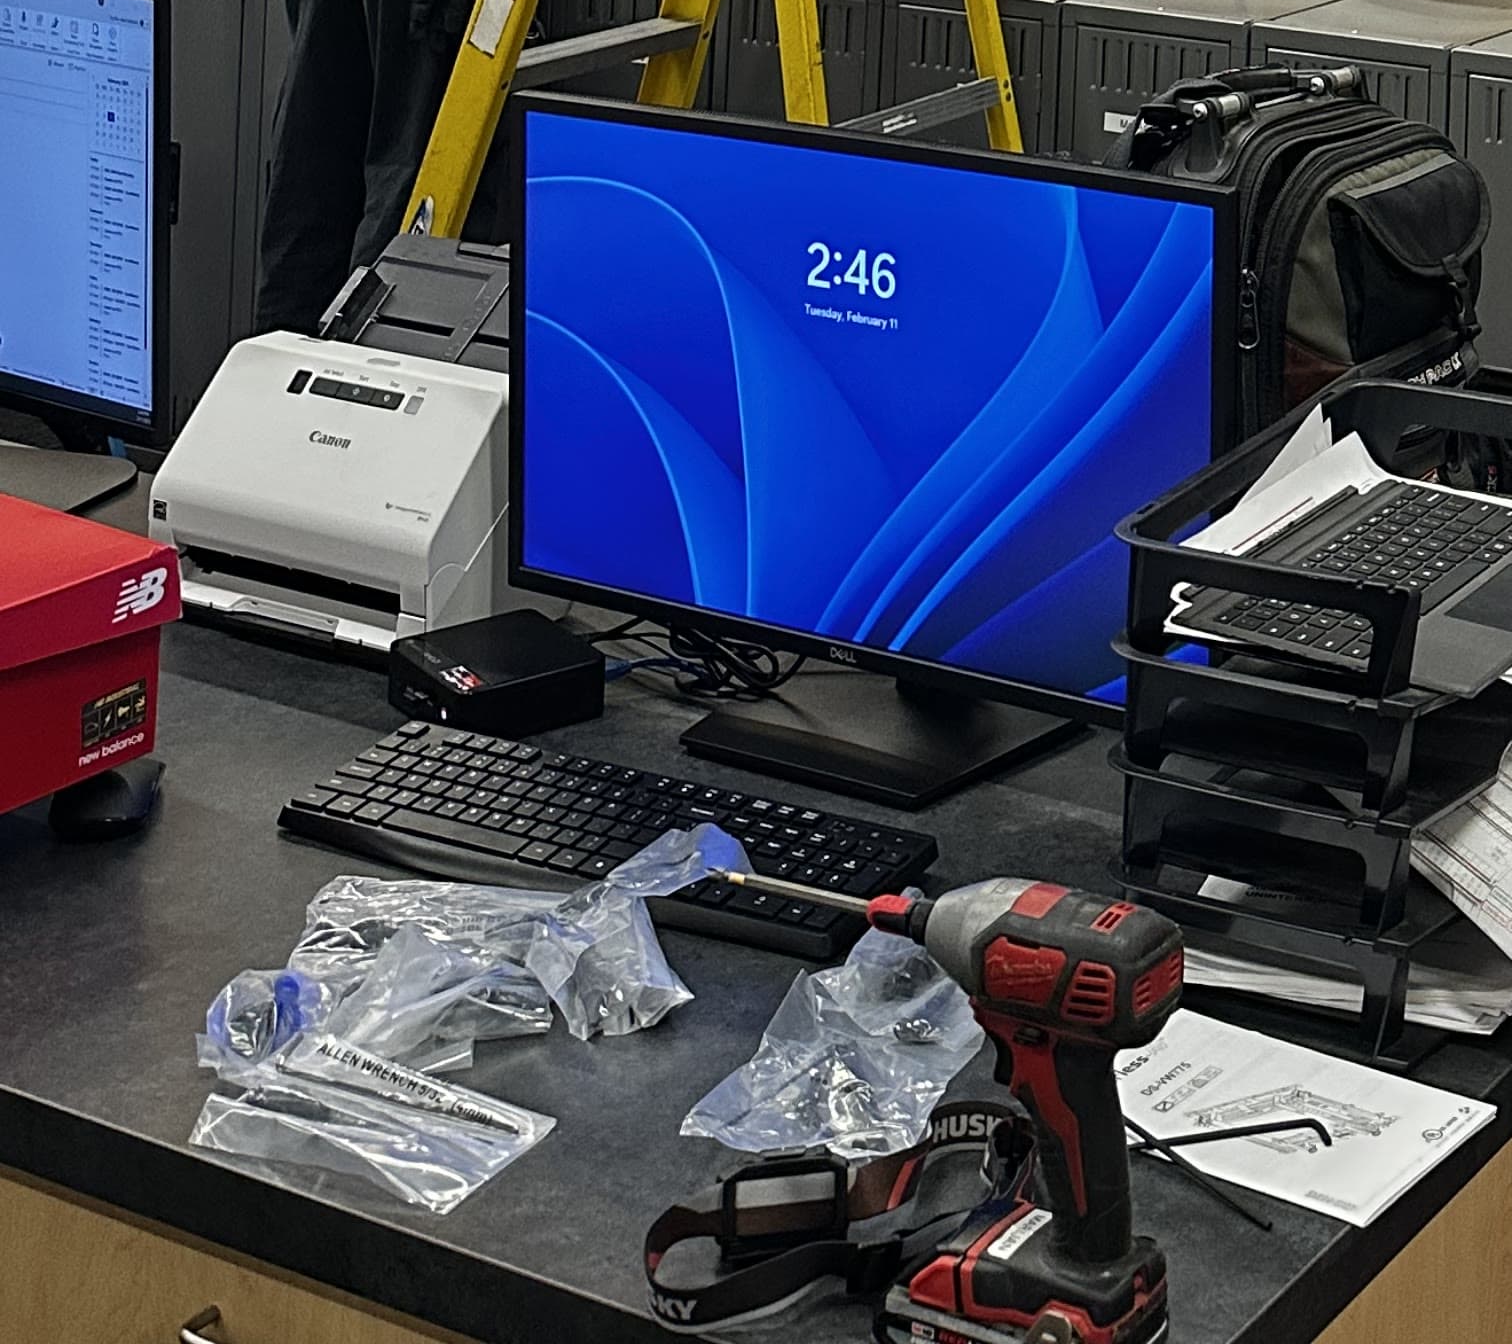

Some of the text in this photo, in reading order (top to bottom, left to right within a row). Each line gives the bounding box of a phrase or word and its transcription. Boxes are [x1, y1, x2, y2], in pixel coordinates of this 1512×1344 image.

[806, 241, 896, 299] 2:46
[804, 303, 899, 330] Tuesday, February 11
[309, 430, 352, 449] Canon
[830, 646, 857, 663] DELL
[78, 731, 145, 768] new balance
[317, 1042, 362, 1067] ALLEN
[360, 1058, 419, 1092] WRENCH
